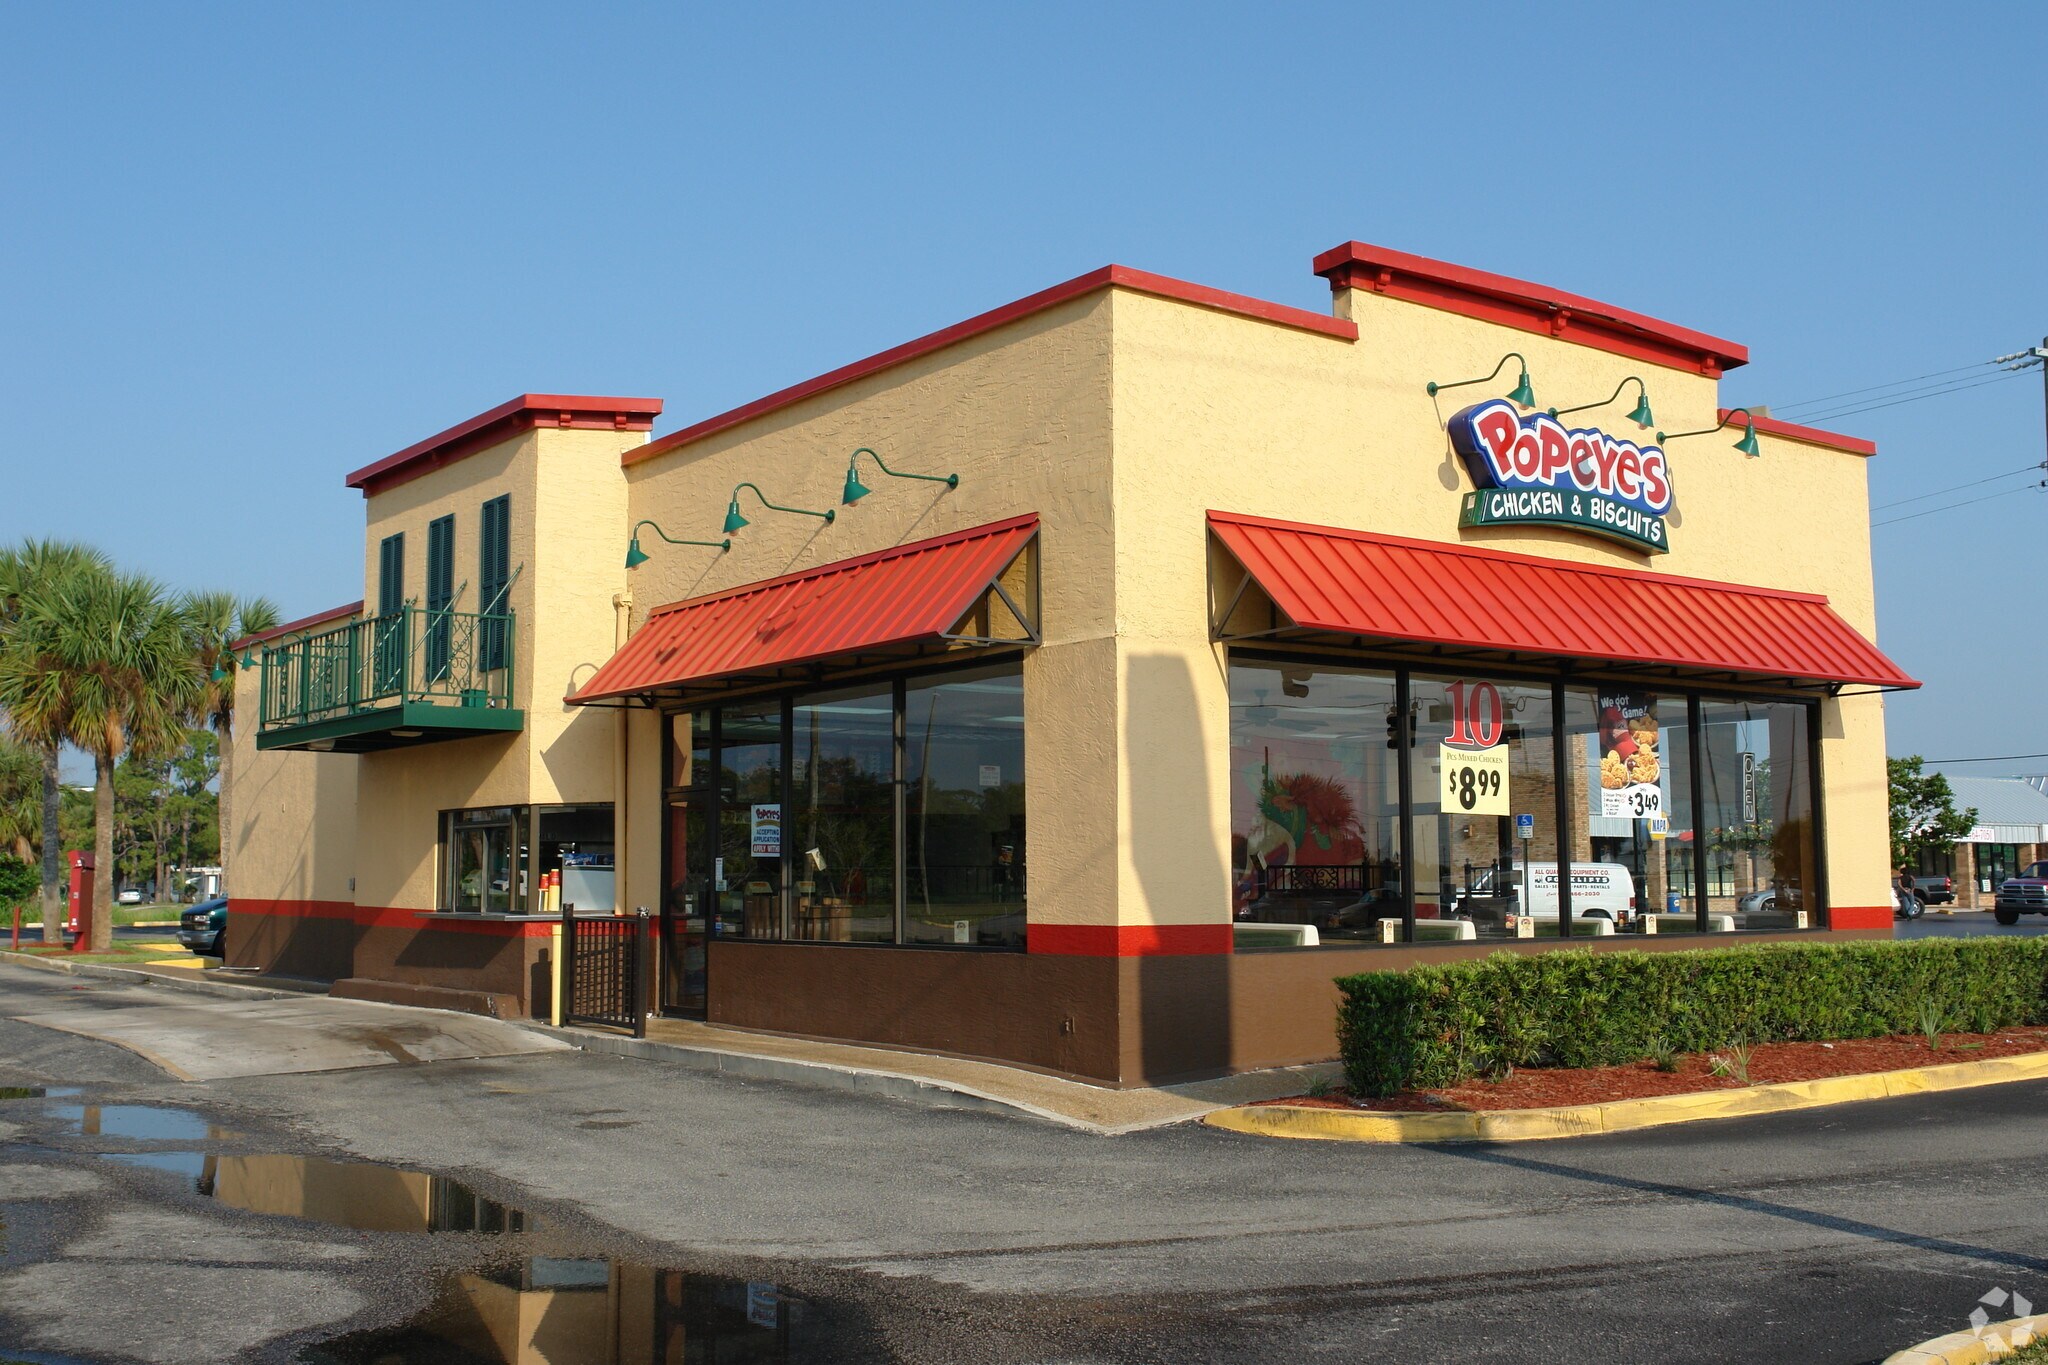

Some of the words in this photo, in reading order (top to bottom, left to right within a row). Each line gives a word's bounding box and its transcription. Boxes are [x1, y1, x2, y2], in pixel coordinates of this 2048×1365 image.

[1490, 491, 1563, 518] CHICKEN
[1570, 495, 1582, 516] &
[1590, 498, 1661, 542] BISCUITS
[1444, 680, 1504, 748] 10
[1600, 697, 1614, 708] We
[1622, 705, 1647, 718] Game!
[1745, 758, 1753, 818] OPEN
[1652, 819, 1667, 832] NAPA
